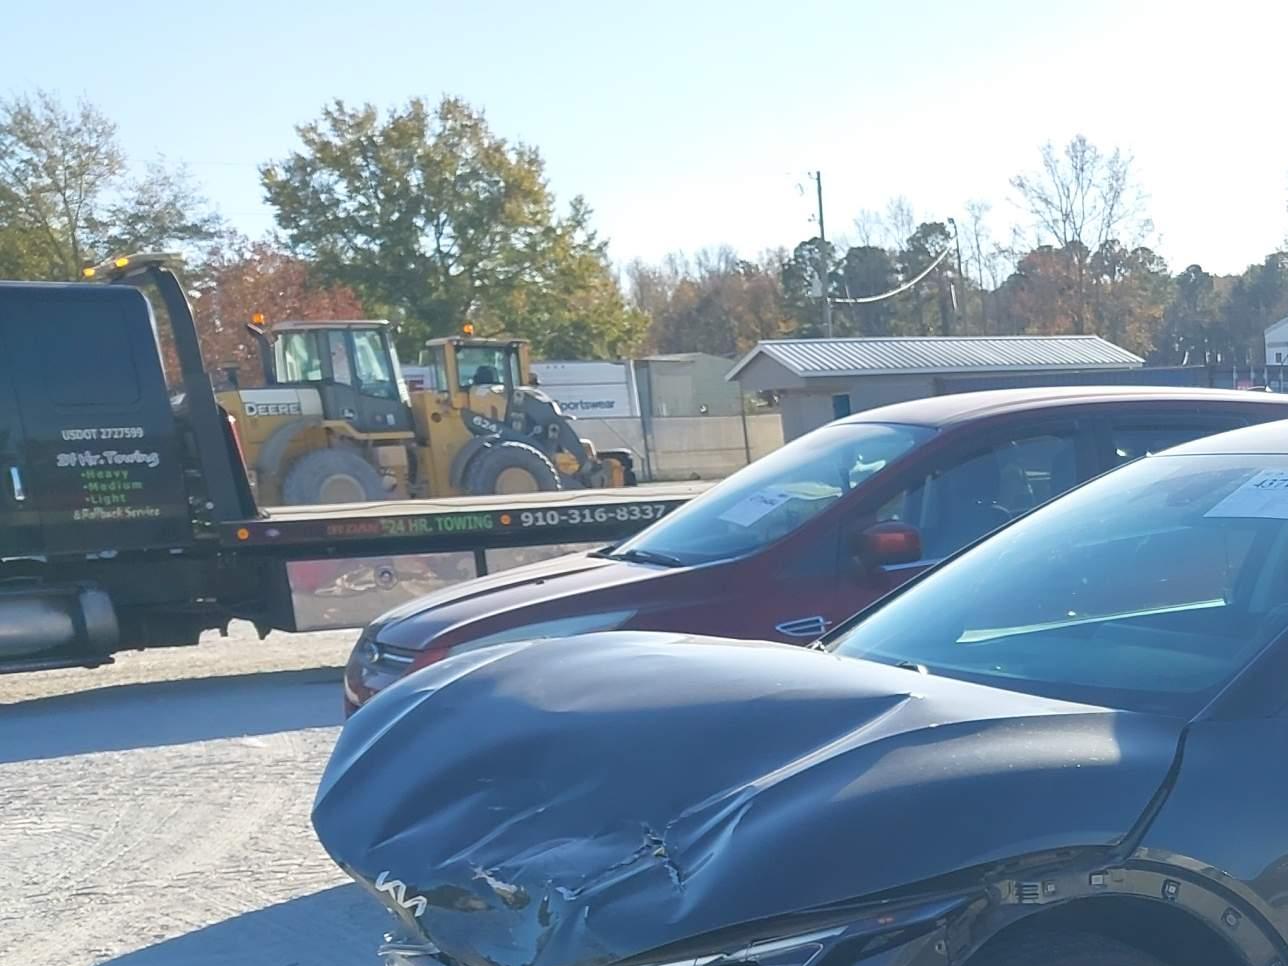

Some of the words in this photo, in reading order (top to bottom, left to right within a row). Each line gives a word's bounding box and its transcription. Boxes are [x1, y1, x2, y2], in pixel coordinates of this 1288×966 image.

[245, 402, 300, 416] DEERE
[61, 429, 97, 441] USDOT
[99, 427, 144, 439] 2727599
[88, 481, 143, 491] Medium
[437, 514, 493, 531] TOWING
[520, 504, 665, 527] 910-316-8337
